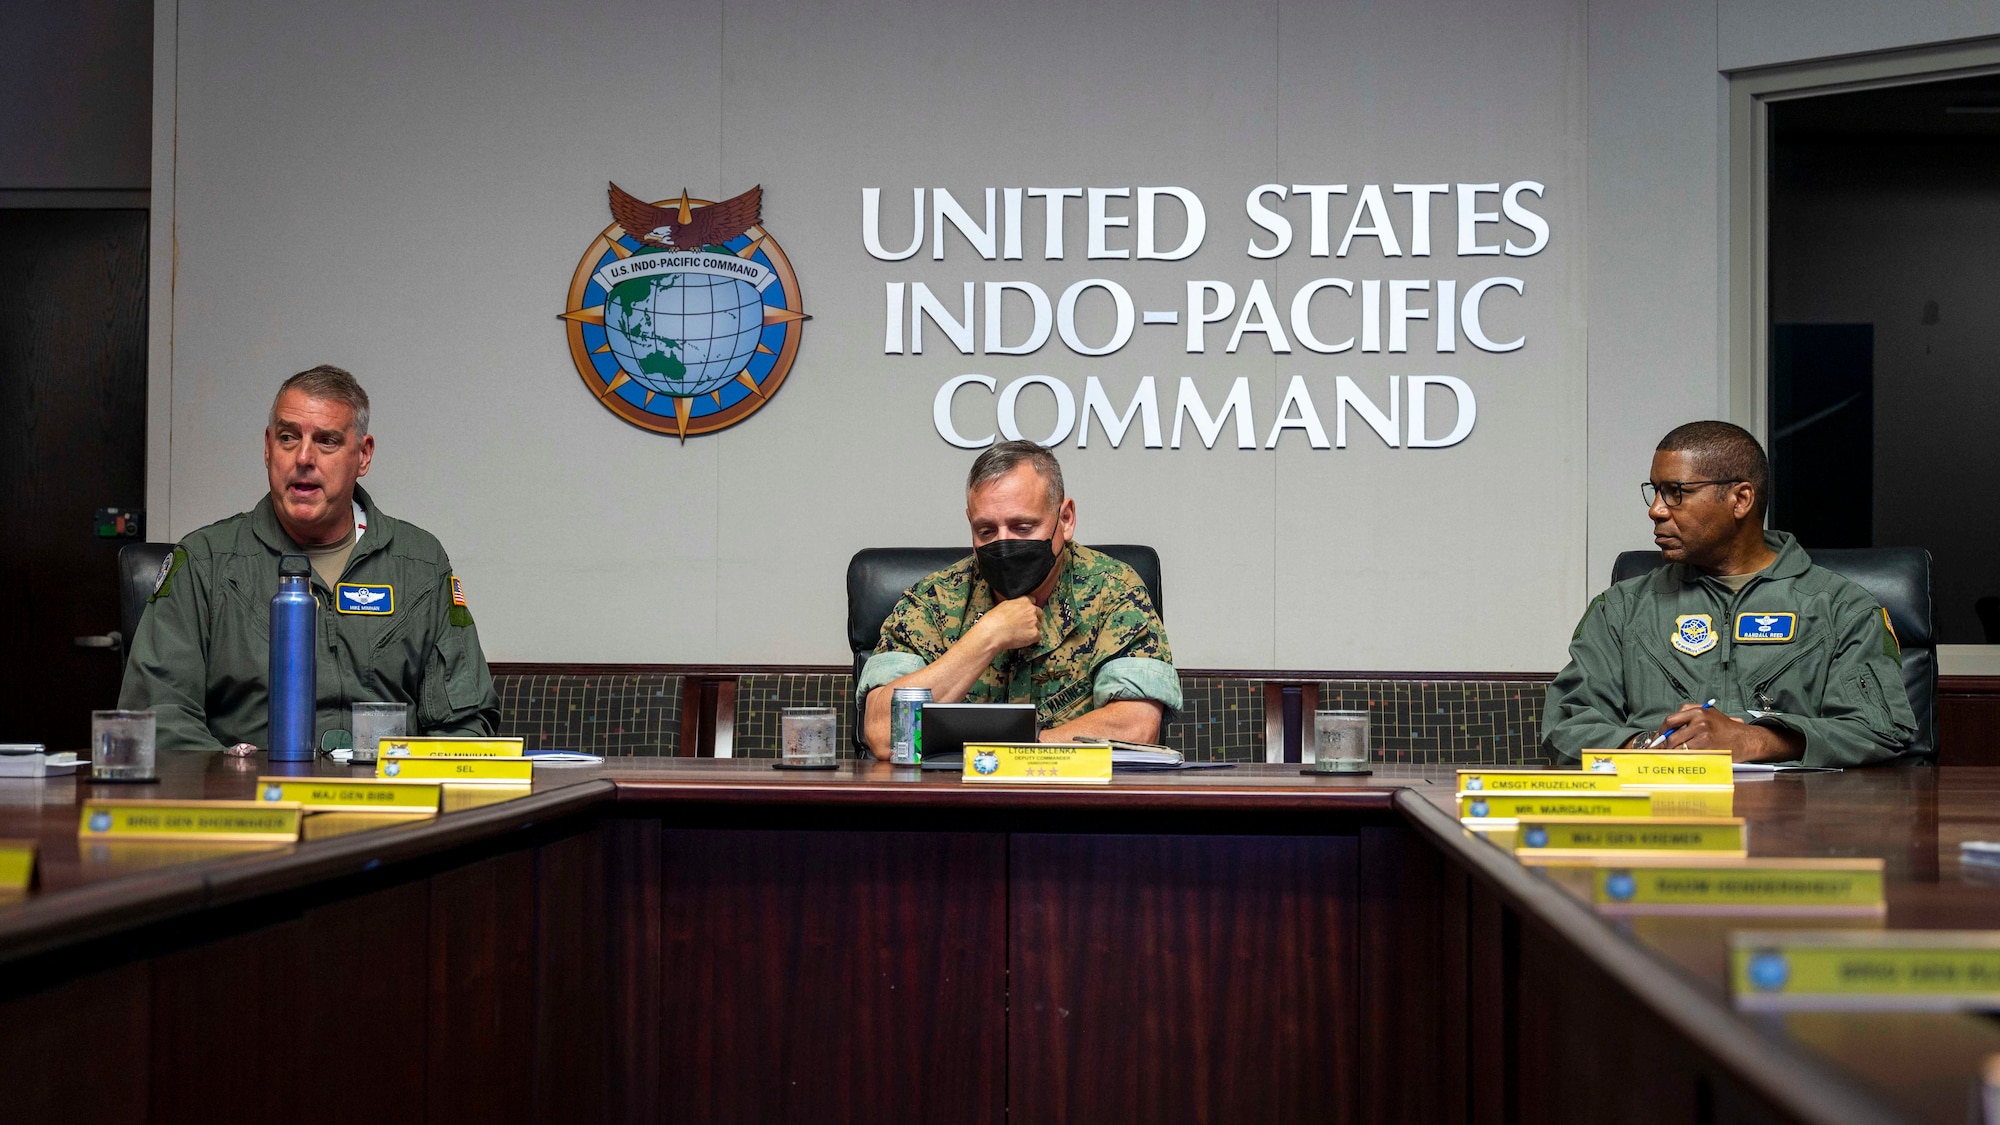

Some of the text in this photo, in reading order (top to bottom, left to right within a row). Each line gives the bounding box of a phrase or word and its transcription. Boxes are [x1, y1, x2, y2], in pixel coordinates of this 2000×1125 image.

[861, 180, 1550, 262] UNITED STATES
[610, 257, 759, 278] U.S. INDO-PACIFIC COMMAND
[884, 276, 1526, 357] INDO-PACIFIC
[932, 373, 1478, 450] COMMAND
[1046, 680, 1090, 714] MARINES
[456, 765, 474, 773] SEL
[1638, 766, 1707, 775] LT GEN REED
[312, 790, 337, 801] MAJ
[339, 790, 364, 801] GEN
[1491, 780, 1597, 790] CMSGT KRUZELNICK
